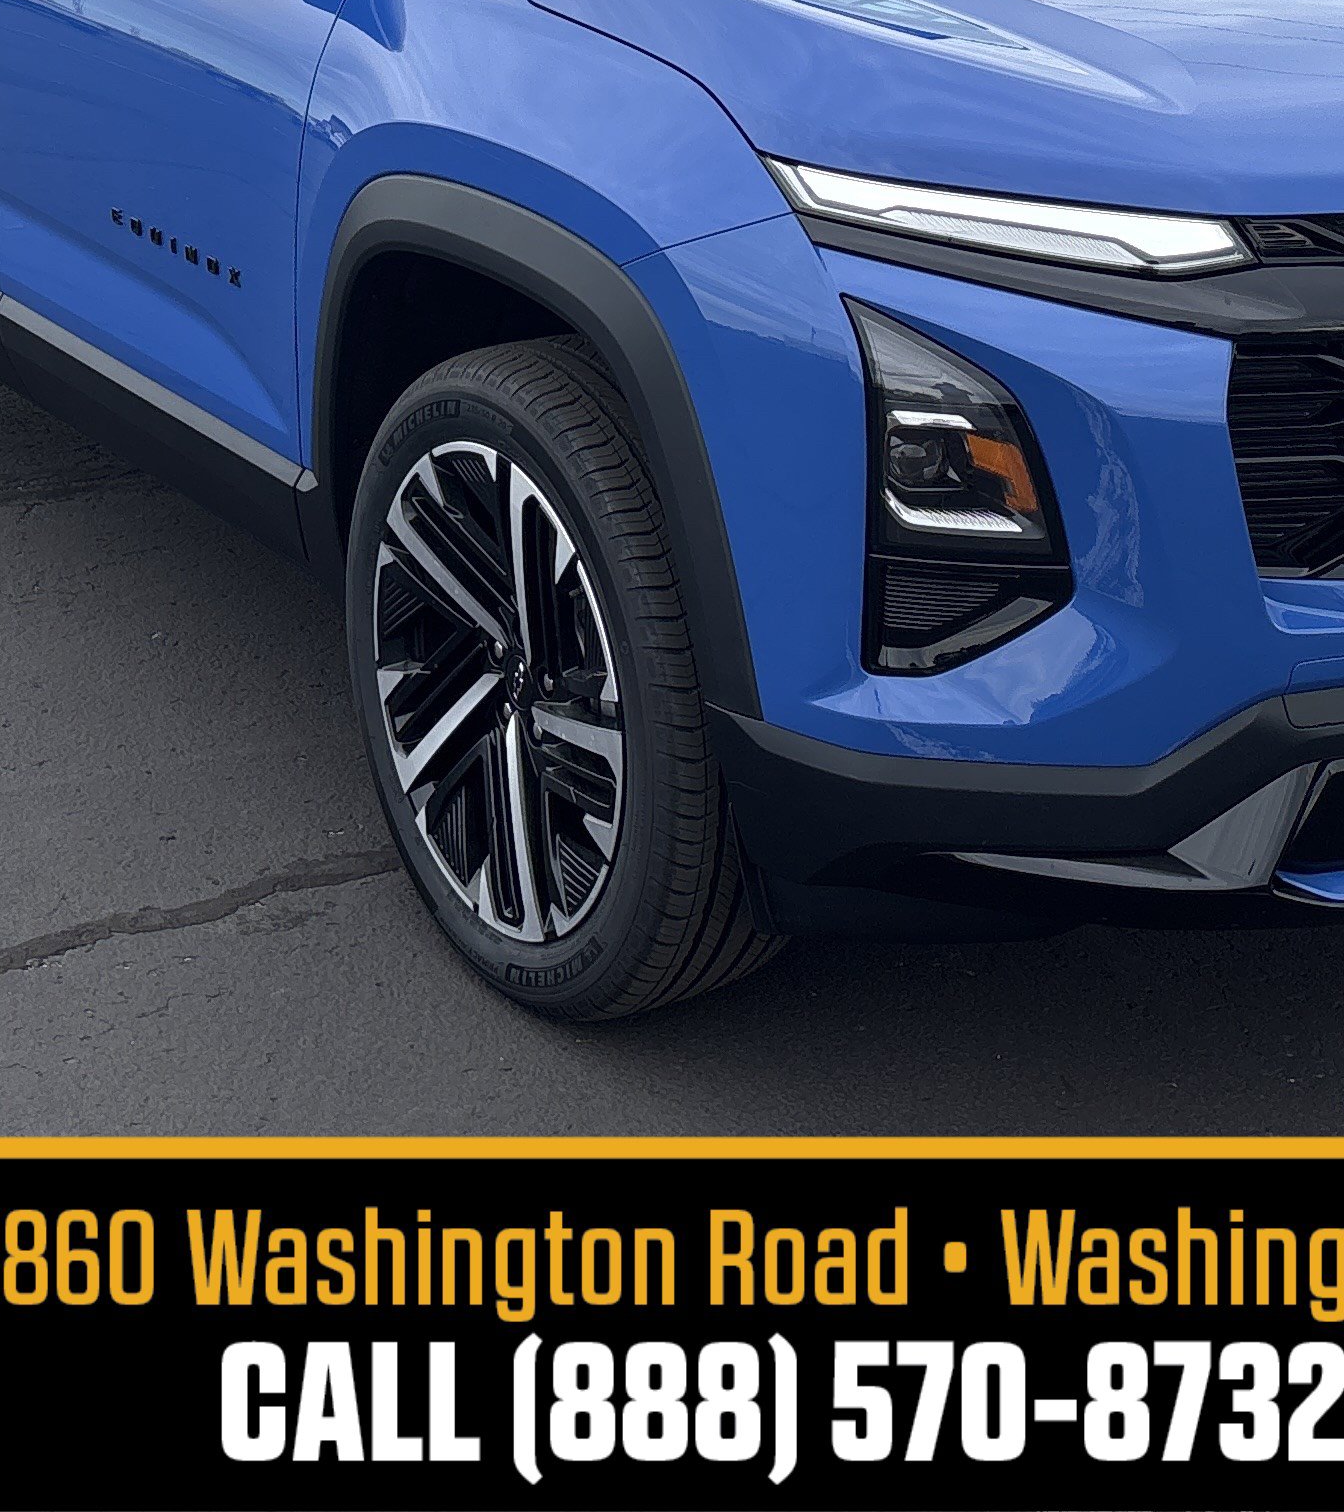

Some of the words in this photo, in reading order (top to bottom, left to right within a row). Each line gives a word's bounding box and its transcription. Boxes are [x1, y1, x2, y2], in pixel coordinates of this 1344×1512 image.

[111, 206, 242, 288] EQUINOX
[392, 400, 457, 447] MICHELIN
[509, 955, 584, 987] MICHELIN
